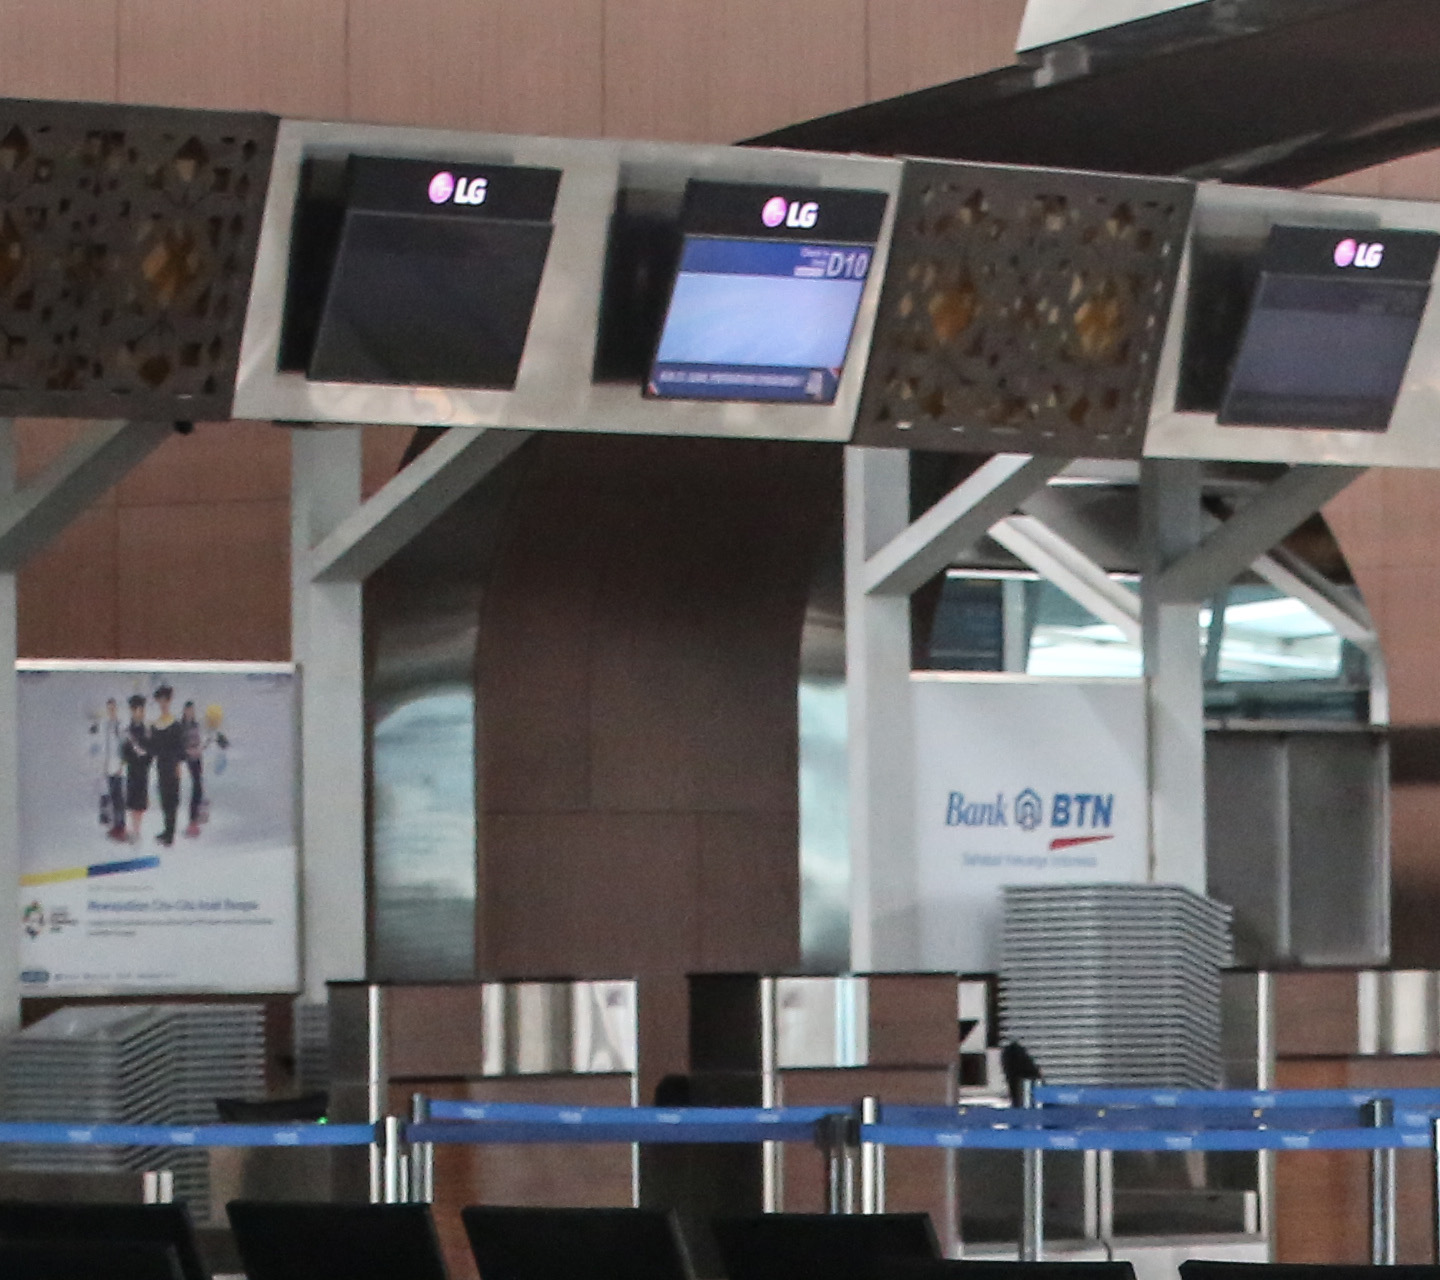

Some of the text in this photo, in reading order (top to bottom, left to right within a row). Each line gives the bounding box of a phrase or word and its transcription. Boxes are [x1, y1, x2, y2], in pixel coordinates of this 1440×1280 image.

[454, 177, 487, 205] LG
[786, 201, 818, 228] LG
[826, 252, 868, 278] D10
[1353, 243, 1384, 268] LG
[945, 790, 1115, 828] Bank BTN
